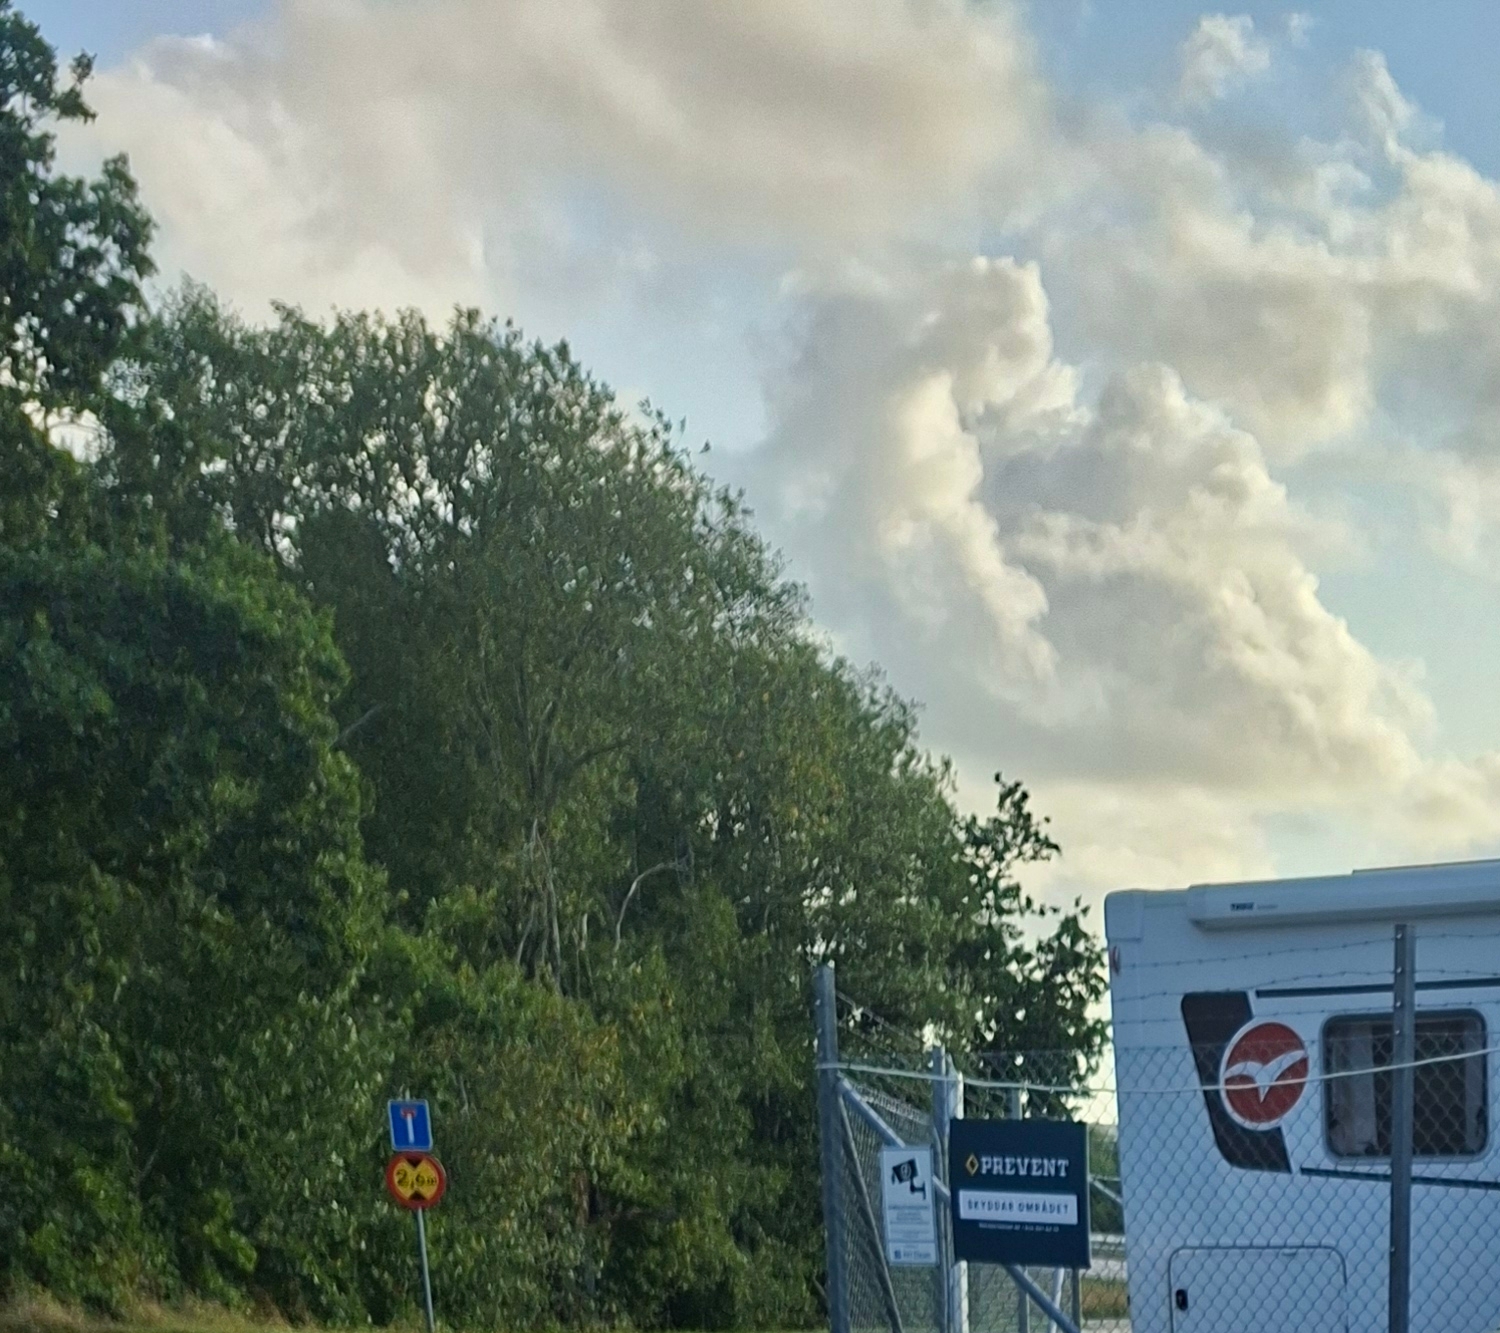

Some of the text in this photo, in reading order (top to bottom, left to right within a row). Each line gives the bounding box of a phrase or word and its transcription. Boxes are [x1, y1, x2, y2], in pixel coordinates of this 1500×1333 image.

[980, 1156, 1069, 1177] PREVENT
[967, 1198, 1069, 1215] SKYDDAR OMRÅDET
